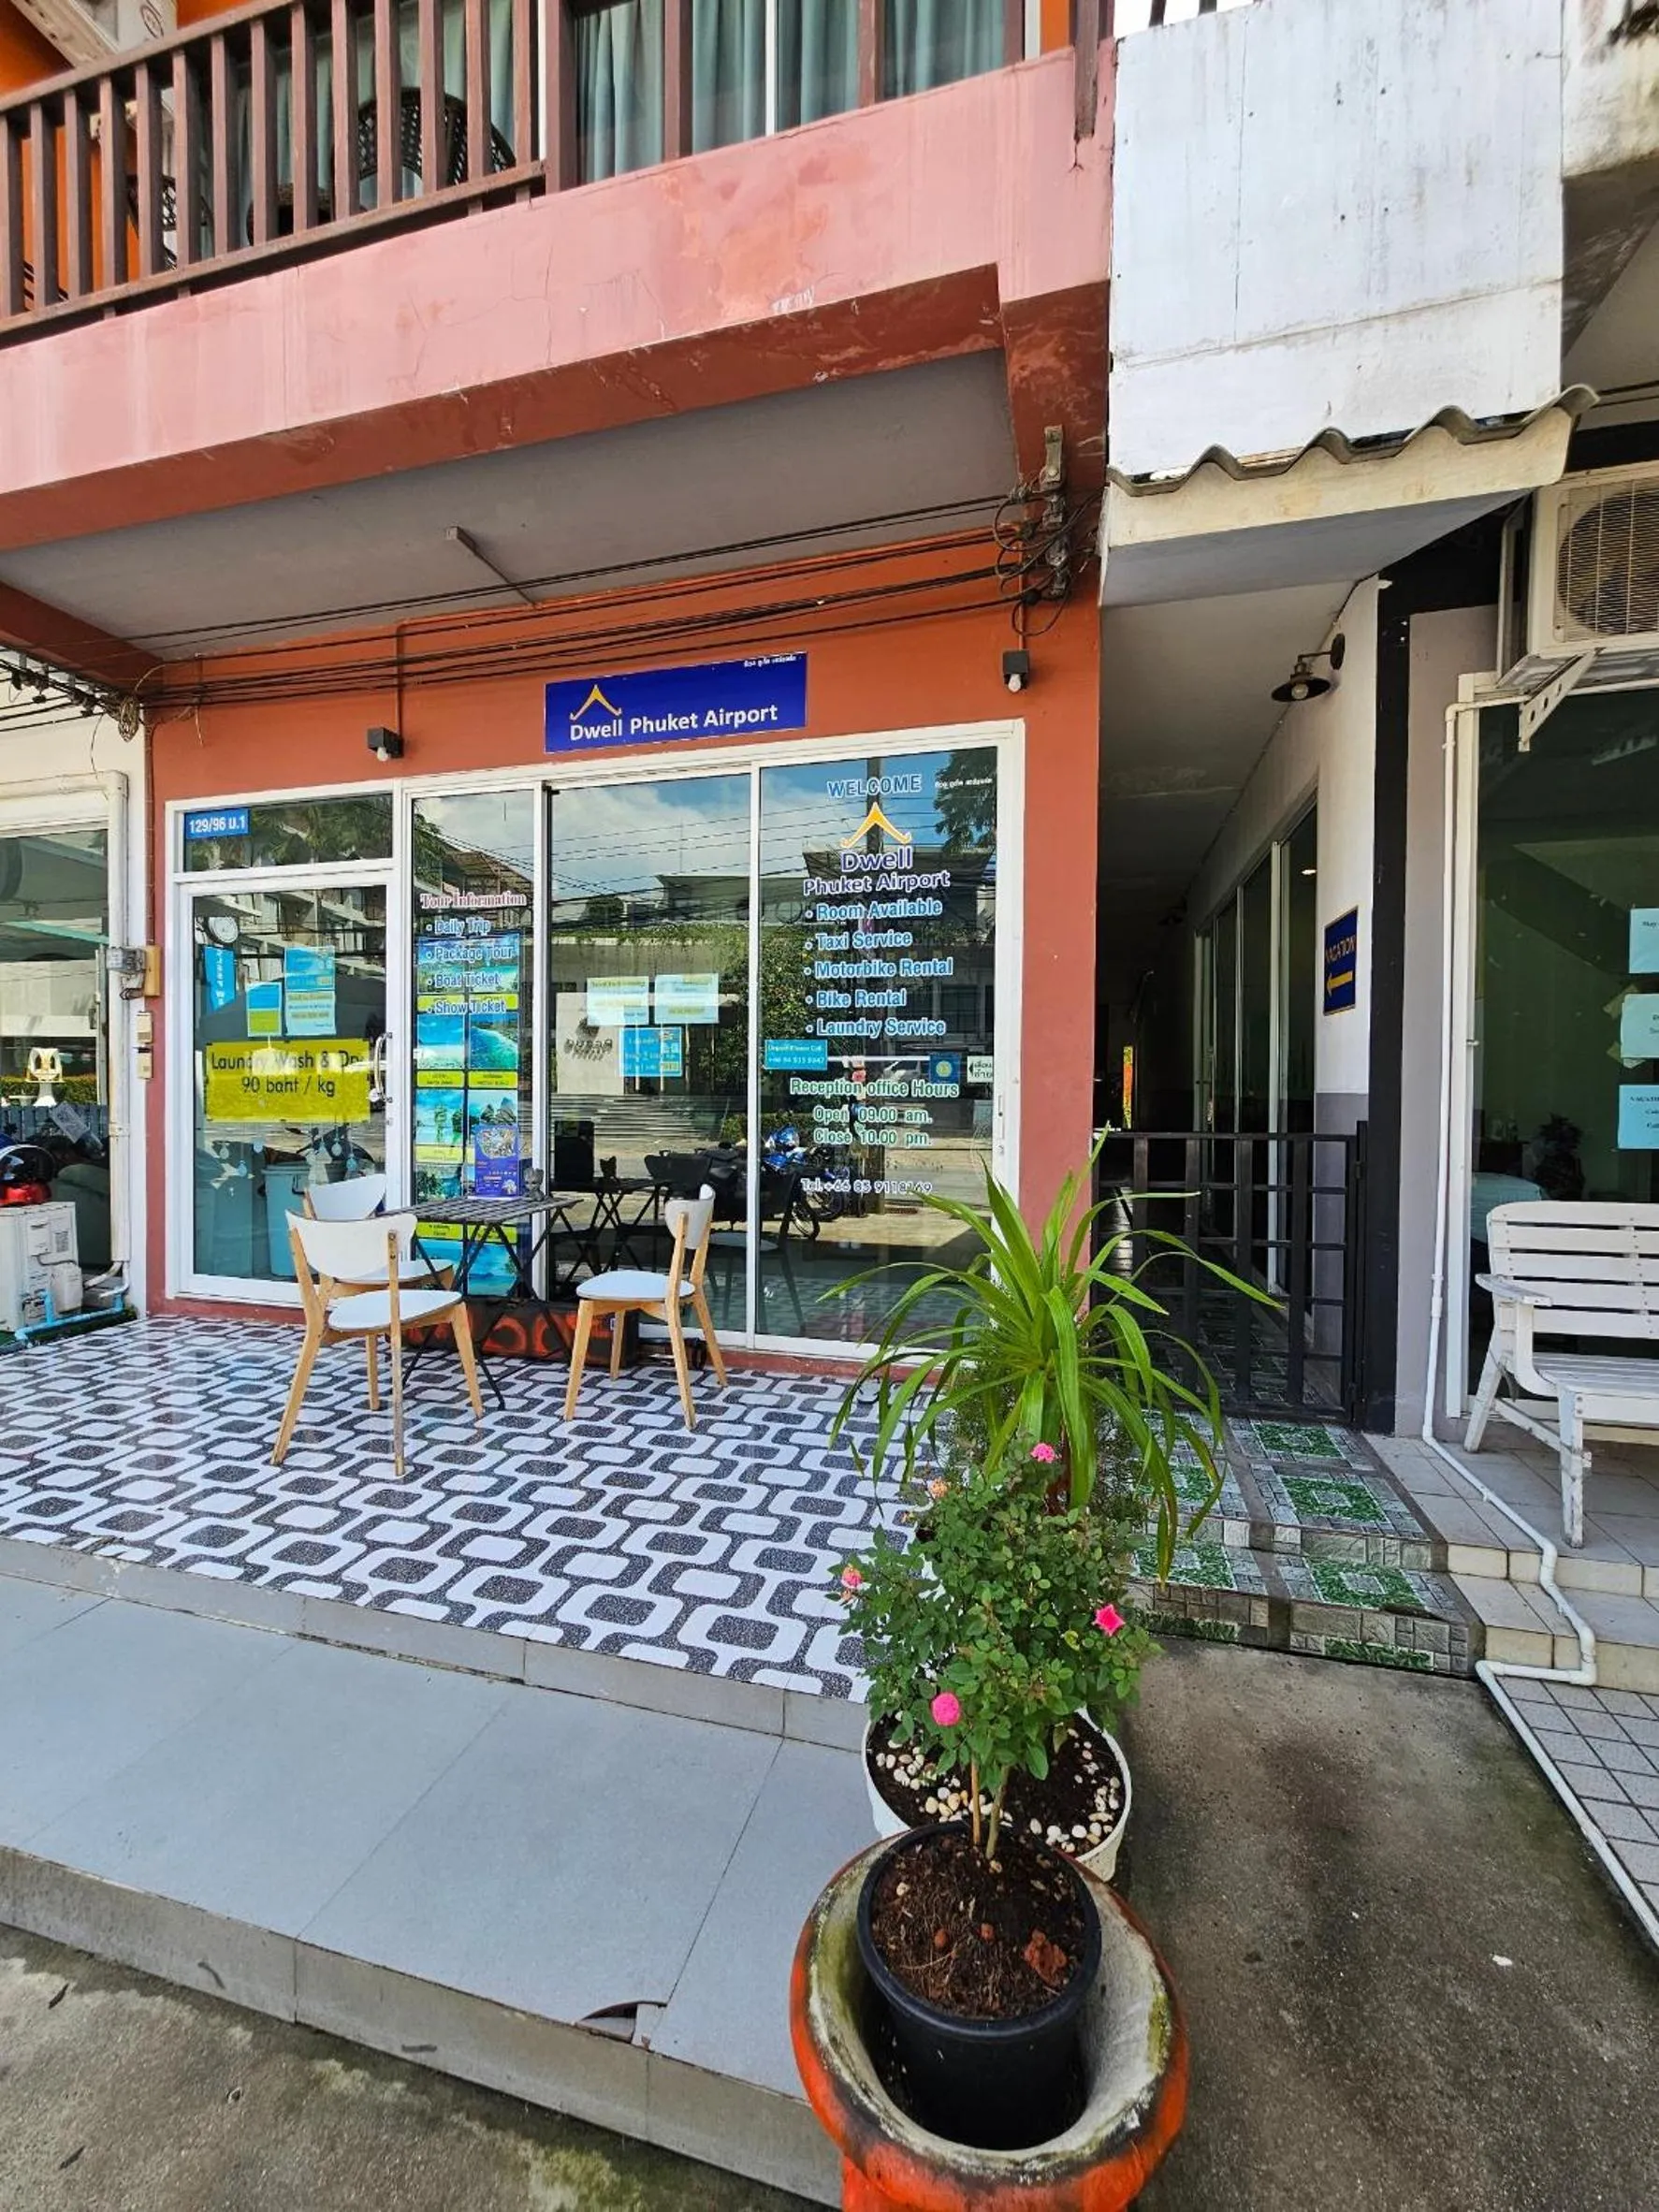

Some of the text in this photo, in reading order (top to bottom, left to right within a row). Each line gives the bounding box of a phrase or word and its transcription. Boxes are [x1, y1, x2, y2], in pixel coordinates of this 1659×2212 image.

[570, 705, 779, 741] Dwell Phuket Airport
[827, 774, 923, 797] WELCOME
[841, 846, 914, 873] Dwell
[804, 870, 951, 896] Phuket Airport
[420, 890, 527, 909] Tour Information
[816, 897, 943, 921] Room Available
[434, 917, 491, 937] Daily Trip
[816, 930, 913, 951] Taxi Service
[814, 956, 953, 978] Motorbike Rental
[434, 1000, 468, 1015] Show
[816, 989, 907, 1008] Bike Rental
[816, 1018, 946, 1038] Laundry Service
[241, 1076, 261, 1094] 90
[317, 1075, 336, 1097] kg
[790, 1078, 960, 1099] Reception office Hours
[813, 1105, 934, 1124] Open 09.00 am.
[813, 1128, 852, 1144] Close
[860, 1129, 898, 1145] 10.00
